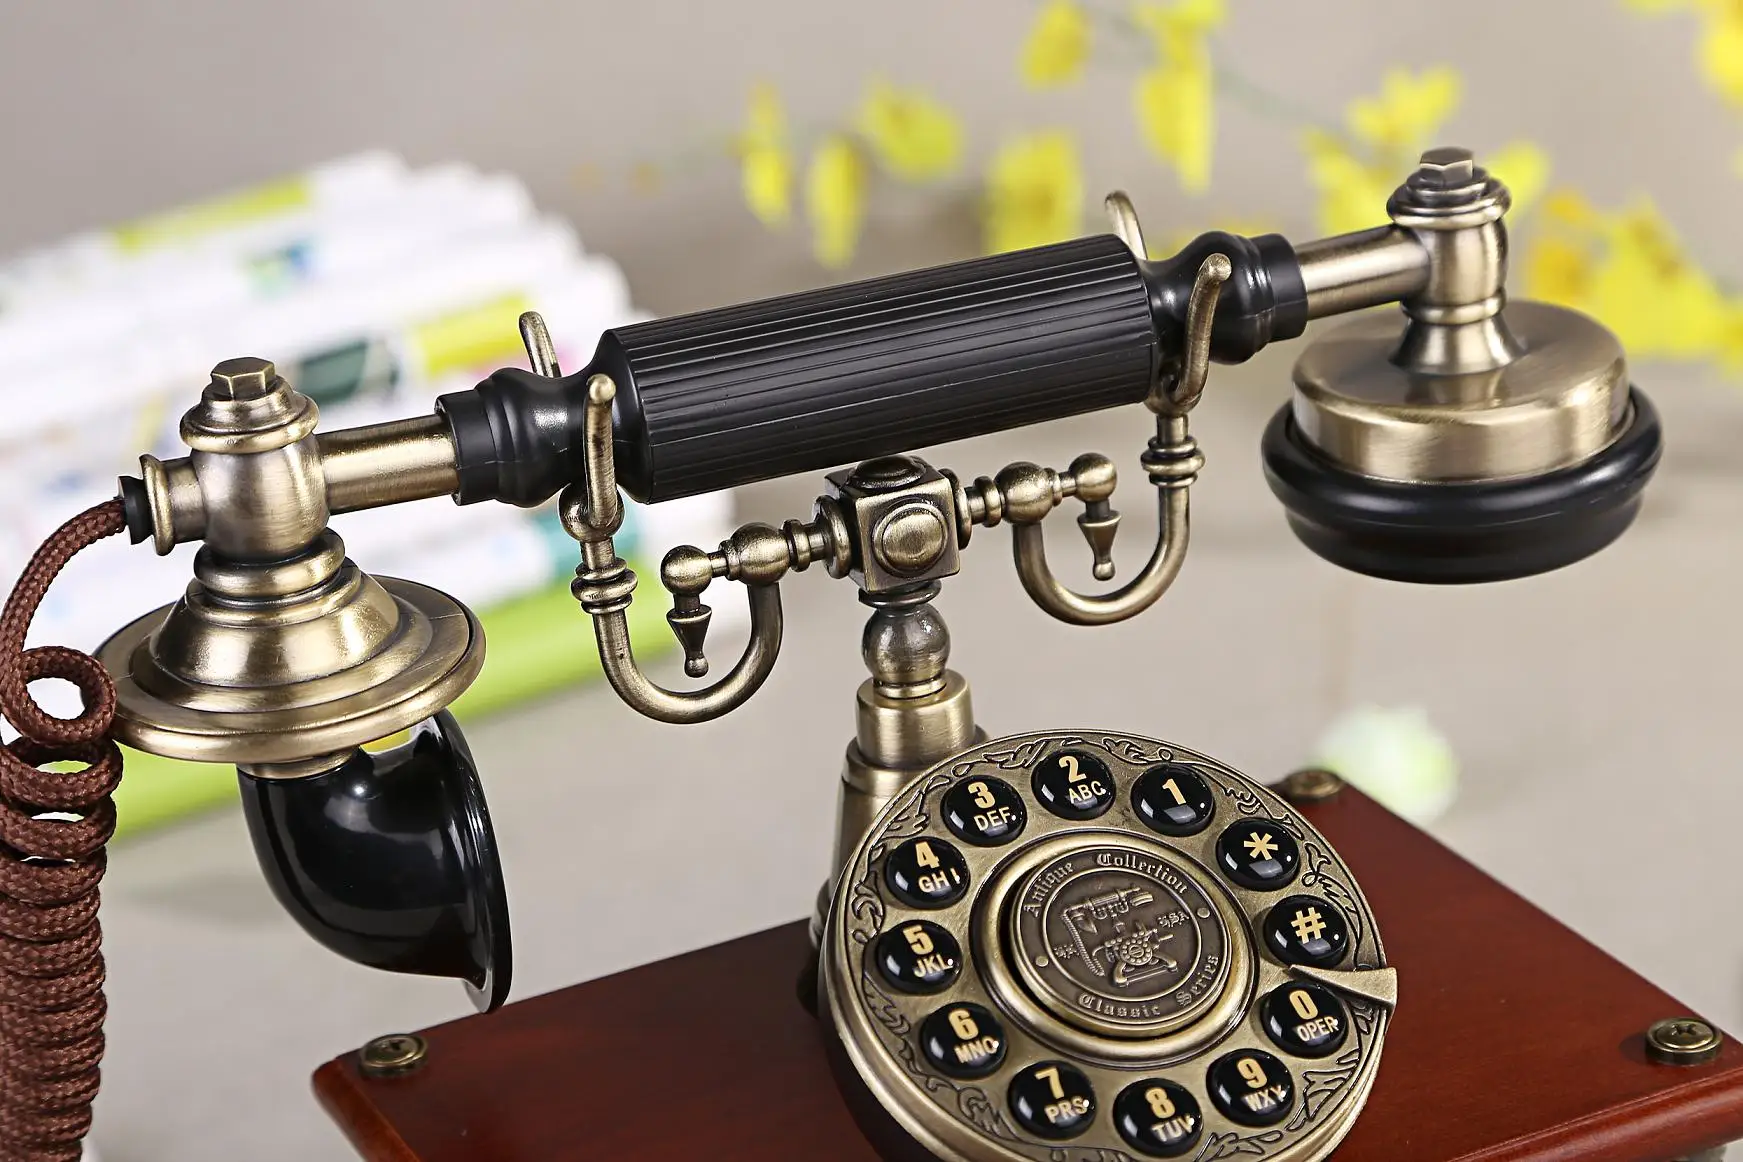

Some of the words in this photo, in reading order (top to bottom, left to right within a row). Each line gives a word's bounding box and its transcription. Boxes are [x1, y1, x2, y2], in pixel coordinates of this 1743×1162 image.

[1058, 755, 1087, 784] 2
[967, 781, 996, 809] 3
[1067, 779, 1106, 804] ABC
[1162, 778, 1187, 806] 1
[973, 806, 1012, 832] DEF
[915, 841, 940, 869] 4
[918, 867, 961, 893] GHI
[1096, 853, 1188, 894] Collection
[902, 924, 934, 956] 5
[913, 953, 954, 979] JKL
[1078, 991, 1161, 1018] Classic
[1175, 954, 1220, 1007] Series
[1288, 989, 1319, 1020] 0
[948, 1007, 979, 1041] 6
[1296, 1014, 1340, 1043] OPER
[953, 1035, 999, 1065] MNO
[1034, 1066, 1065, 1100] 7
[1236, 1057, 1268, 1089] 9
[1043, 1094, 1089, 1124] PRS
[1144, 1086, 1176, 1120] 8
[1151, 1114, 1195, 1143] TUV
